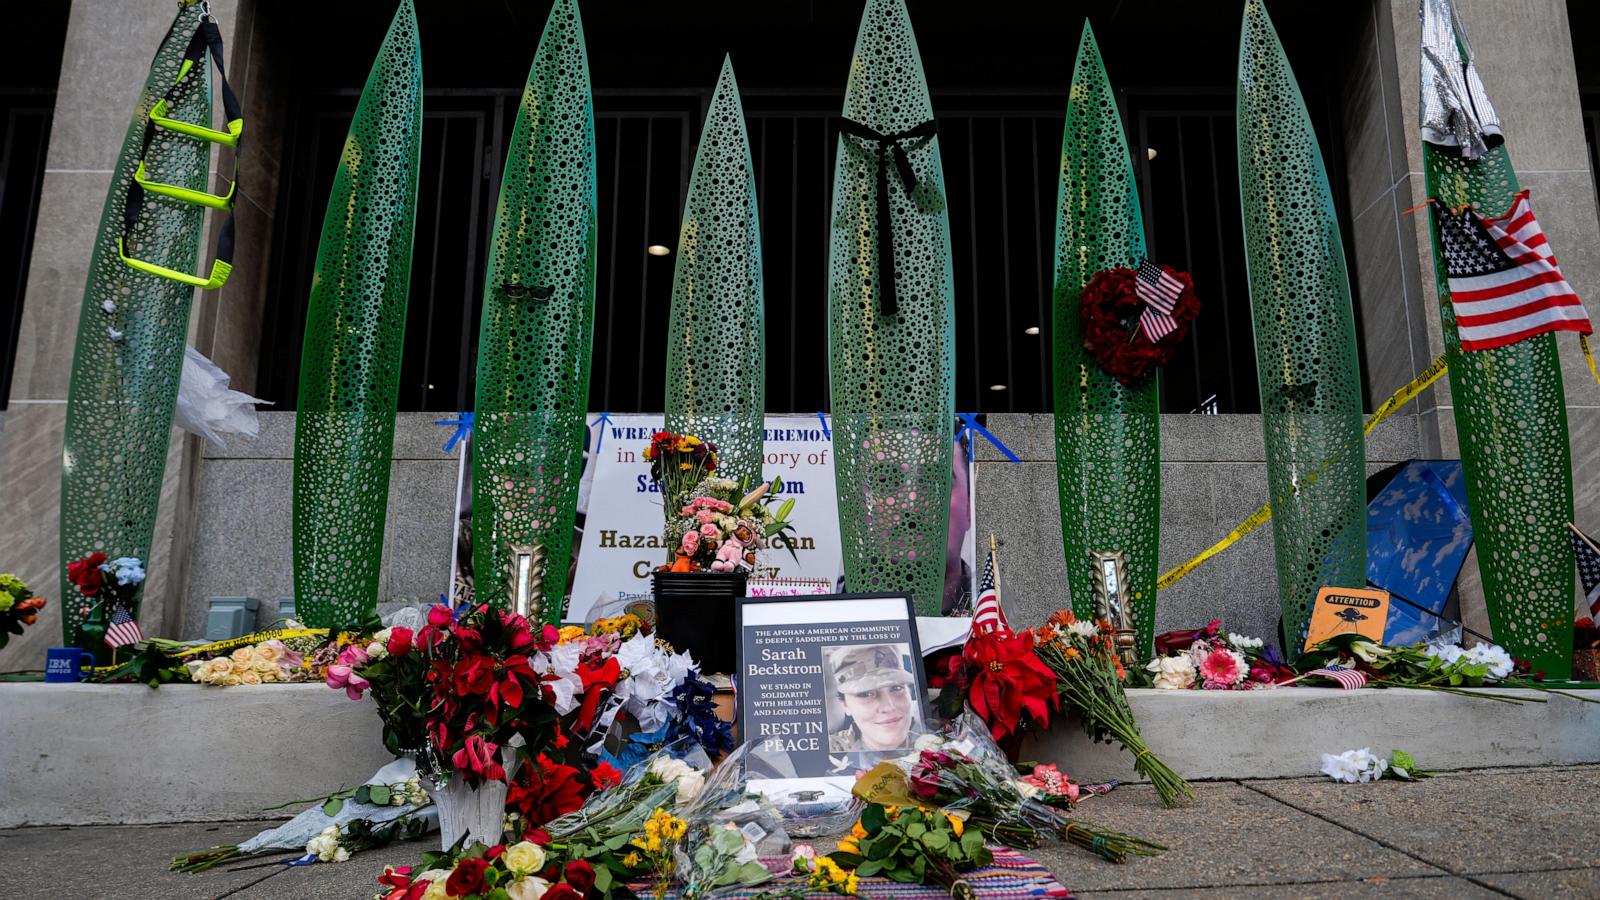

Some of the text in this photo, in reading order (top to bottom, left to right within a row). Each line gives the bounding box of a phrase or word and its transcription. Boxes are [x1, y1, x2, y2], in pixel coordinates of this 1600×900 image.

[612, 428, 832, 442] WREA EREMON
[617, 448, 636, 462] in
[808, 450, 828, 464] of
[1329, 596, 1375, 607] ATTENTION
[762, 647, 806, 661] Sarah
[49, 659, 71, 668] IBM
[748, 663, 822, 676] Beckstrom
[760, 721, 823, 736] REST IN
[764, 738, 820, 752] PEACE
